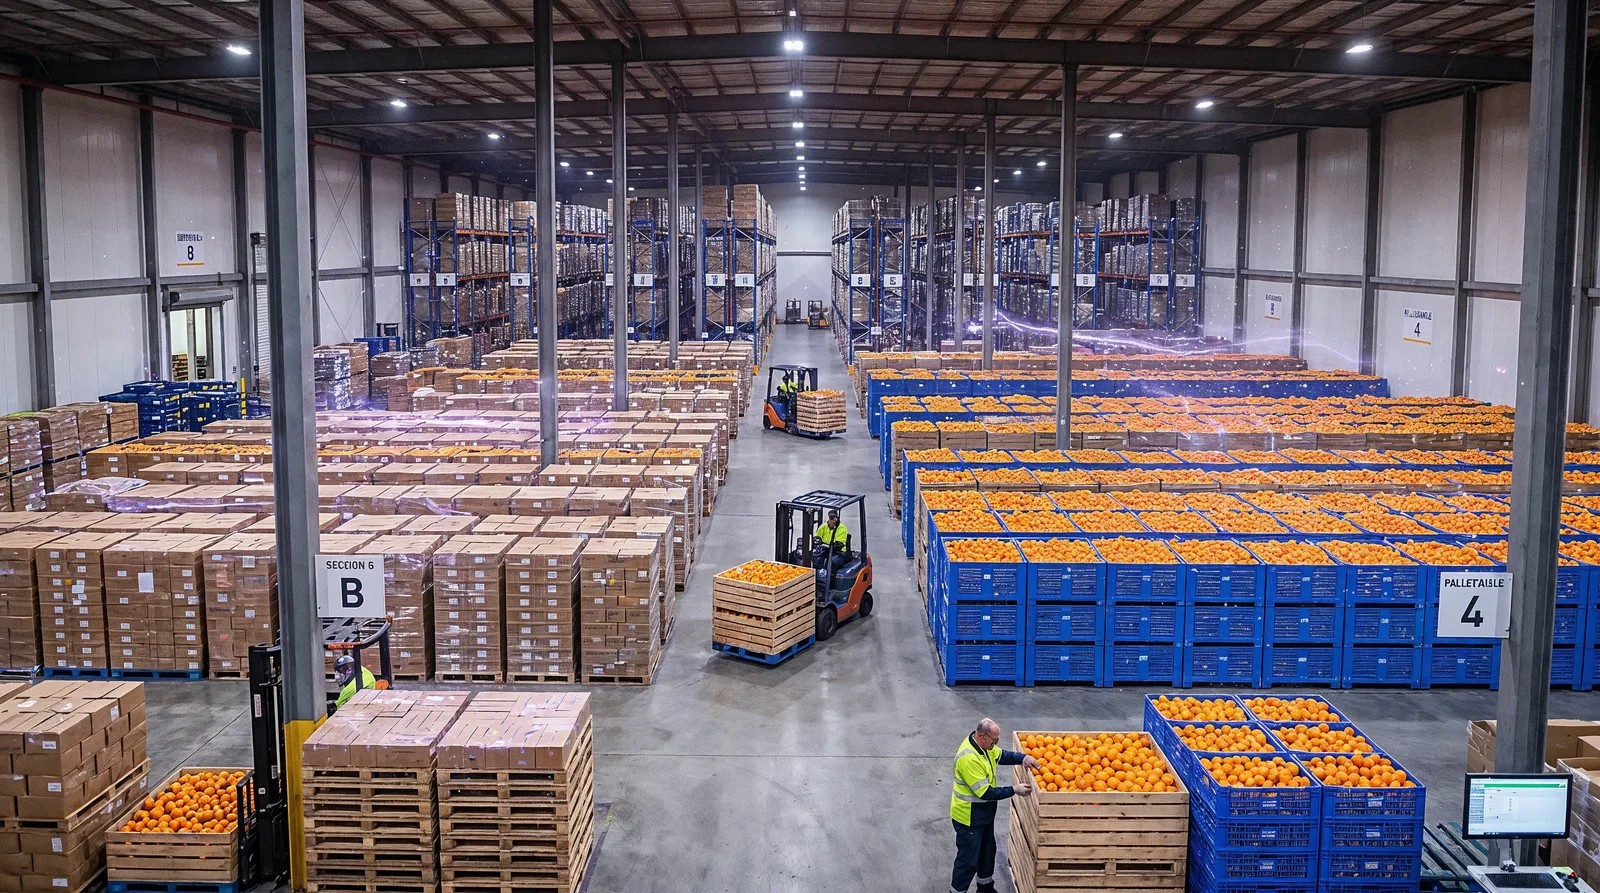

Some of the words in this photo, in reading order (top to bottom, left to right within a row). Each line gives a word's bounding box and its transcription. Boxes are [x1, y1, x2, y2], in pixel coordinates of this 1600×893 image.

[187, 245, 194, 261] 8
[1414, 322, 1421, 337] 4
[368, 561, 374, 570] 6
[340, 577, 364, 608] B
[1460, 595, 1484, 628] 4
